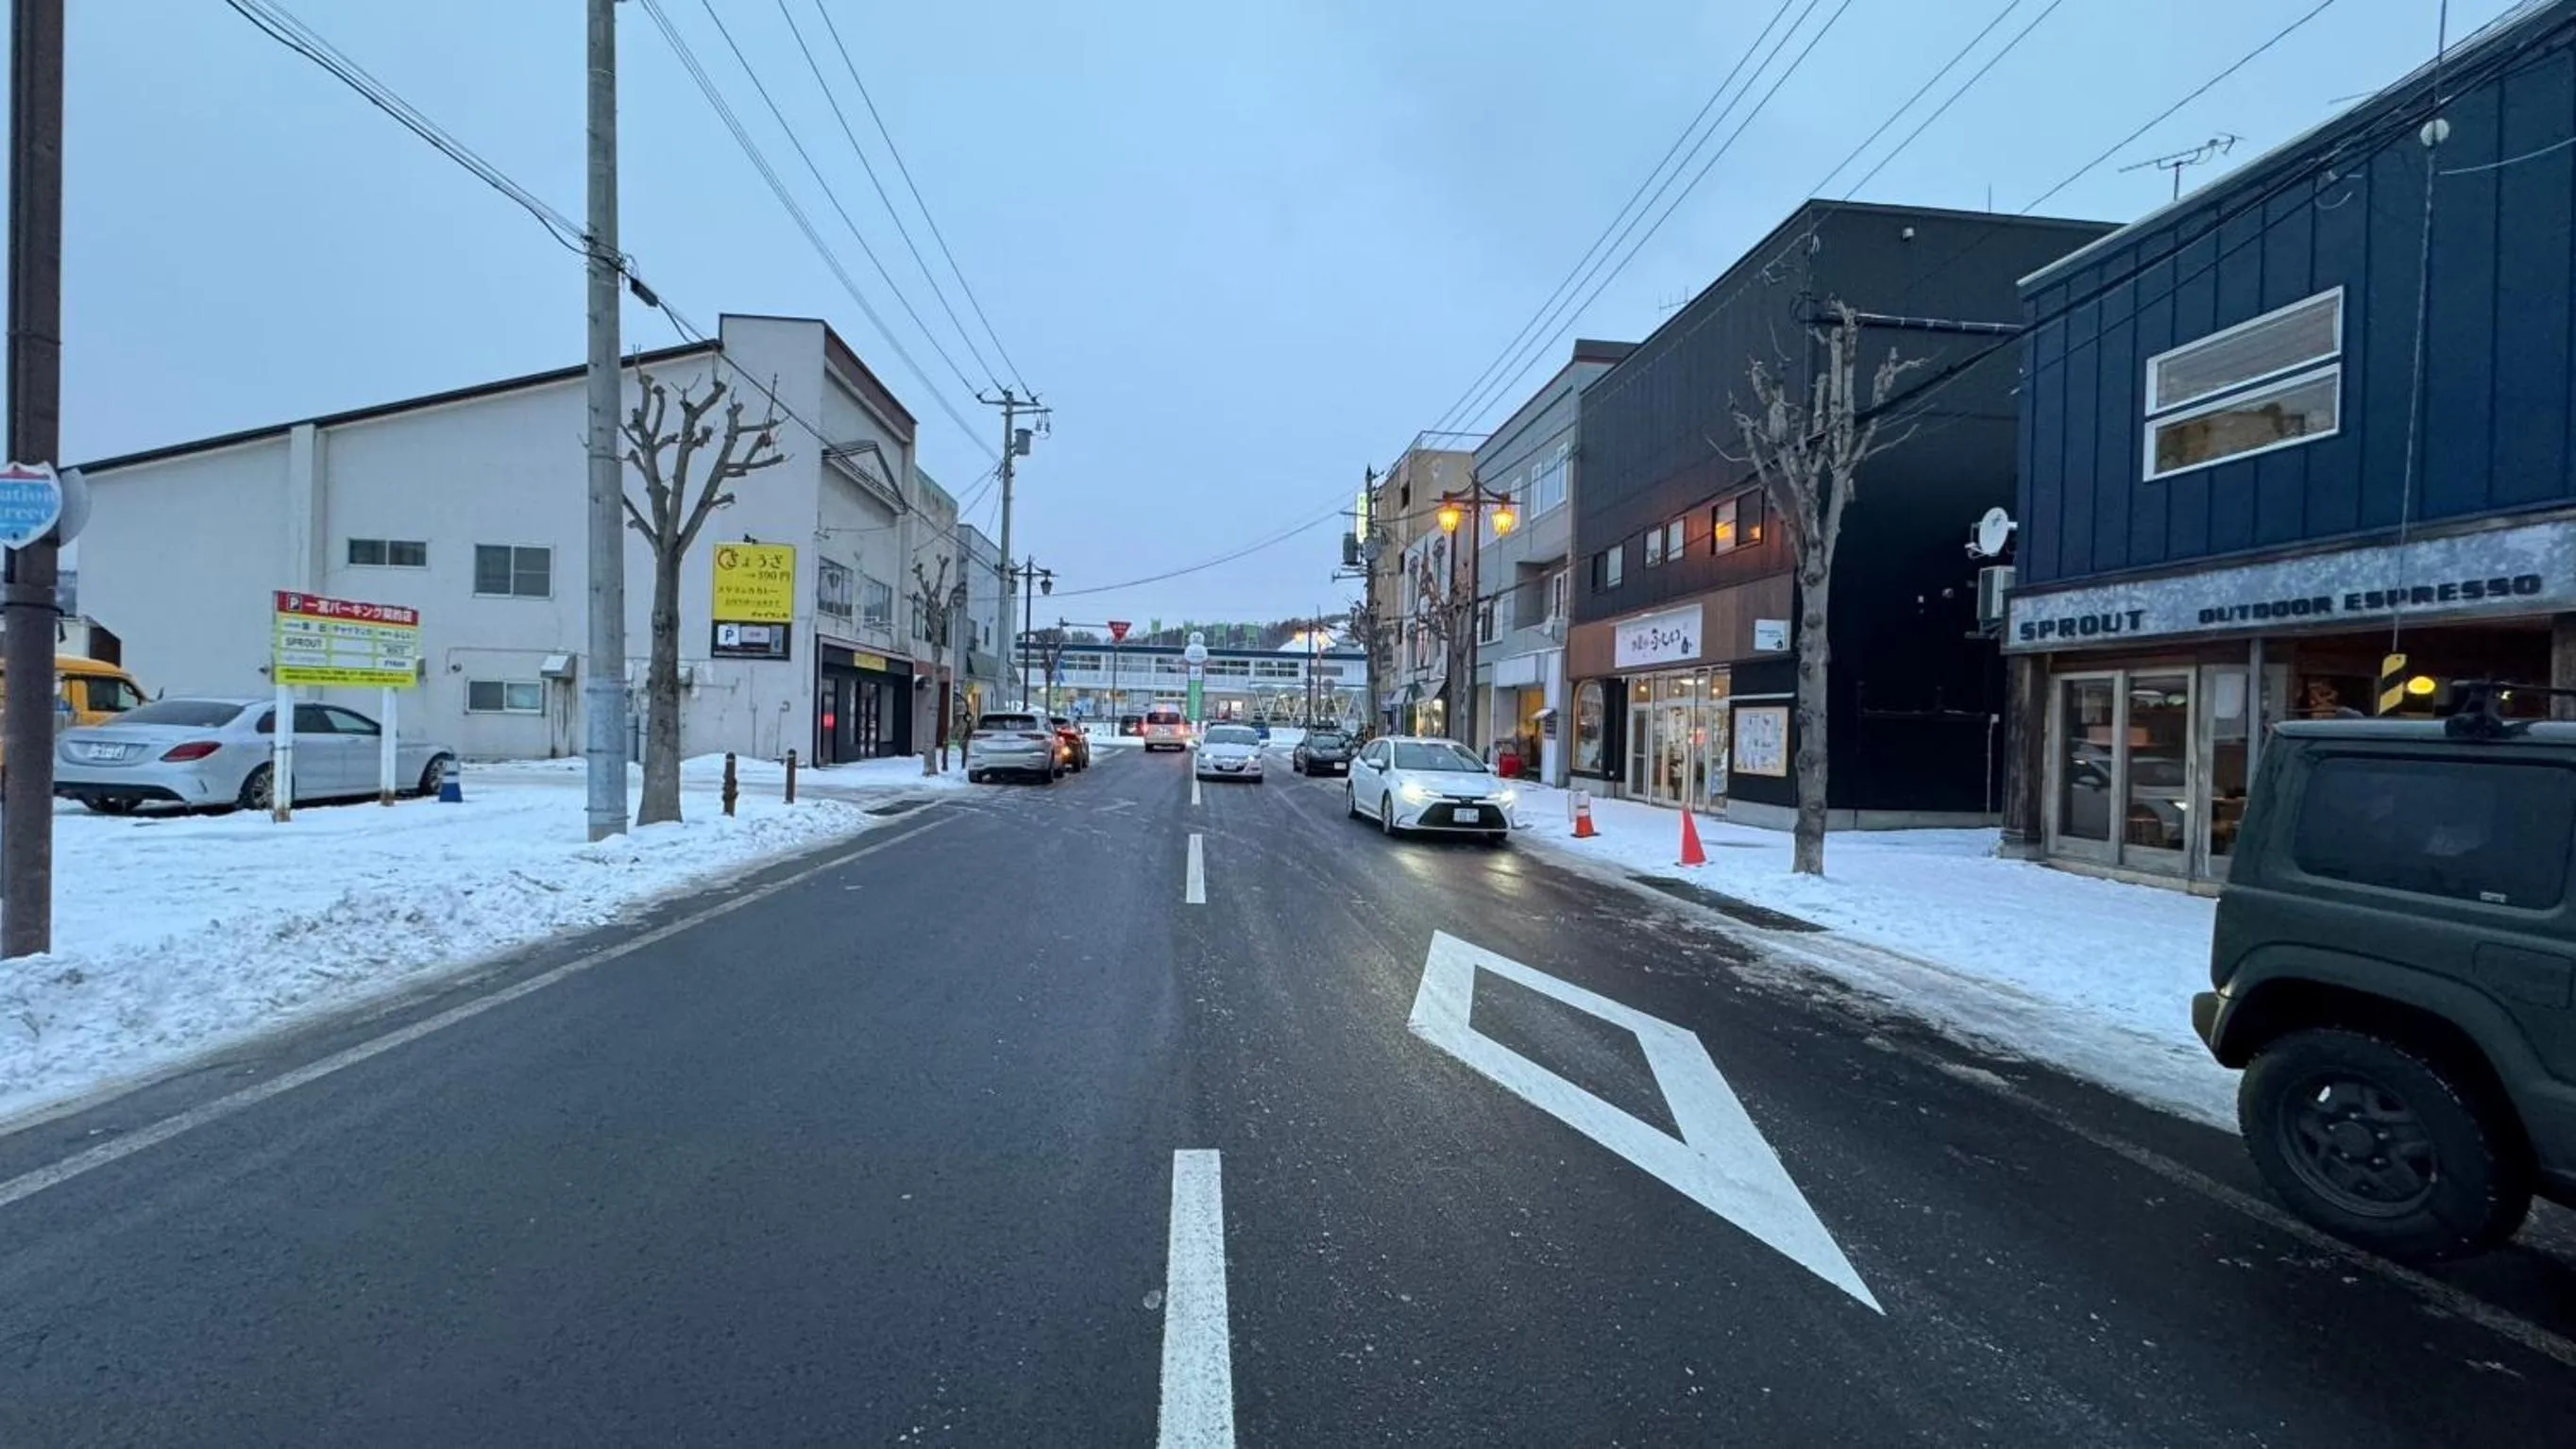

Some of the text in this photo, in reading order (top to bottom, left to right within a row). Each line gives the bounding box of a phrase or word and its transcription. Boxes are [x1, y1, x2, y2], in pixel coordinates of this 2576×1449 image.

[290, 597, 299, 609] P
[2197, 574, 2542, 625] OUTDOOR ESPRESSO
[2020, 609, 2146, 641] SPROUT
[725, 630, 734, 641] P
[285, 636, 322, 648] SPROUT
